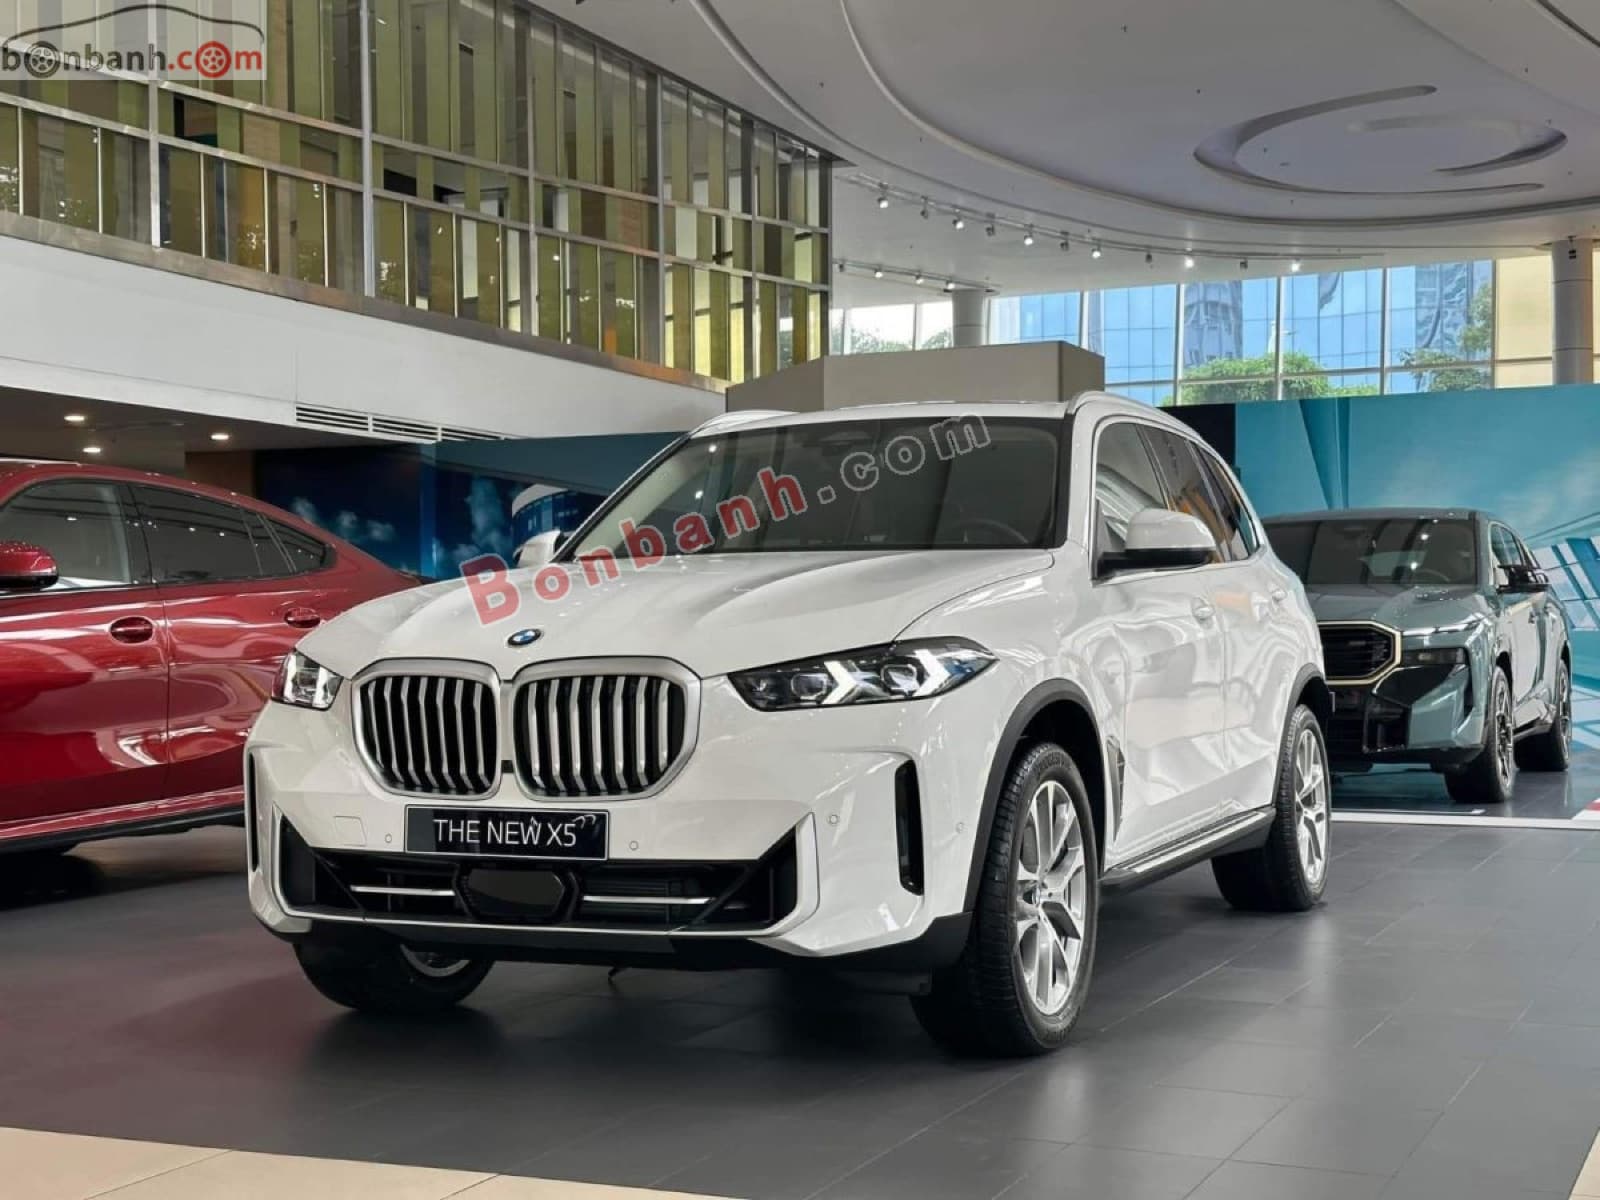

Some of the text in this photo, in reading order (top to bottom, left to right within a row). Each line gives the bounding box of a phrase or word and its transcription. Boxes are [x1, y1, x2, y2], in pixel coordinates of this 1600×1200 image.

[433, 819, 577, 847] THE NEW X5
